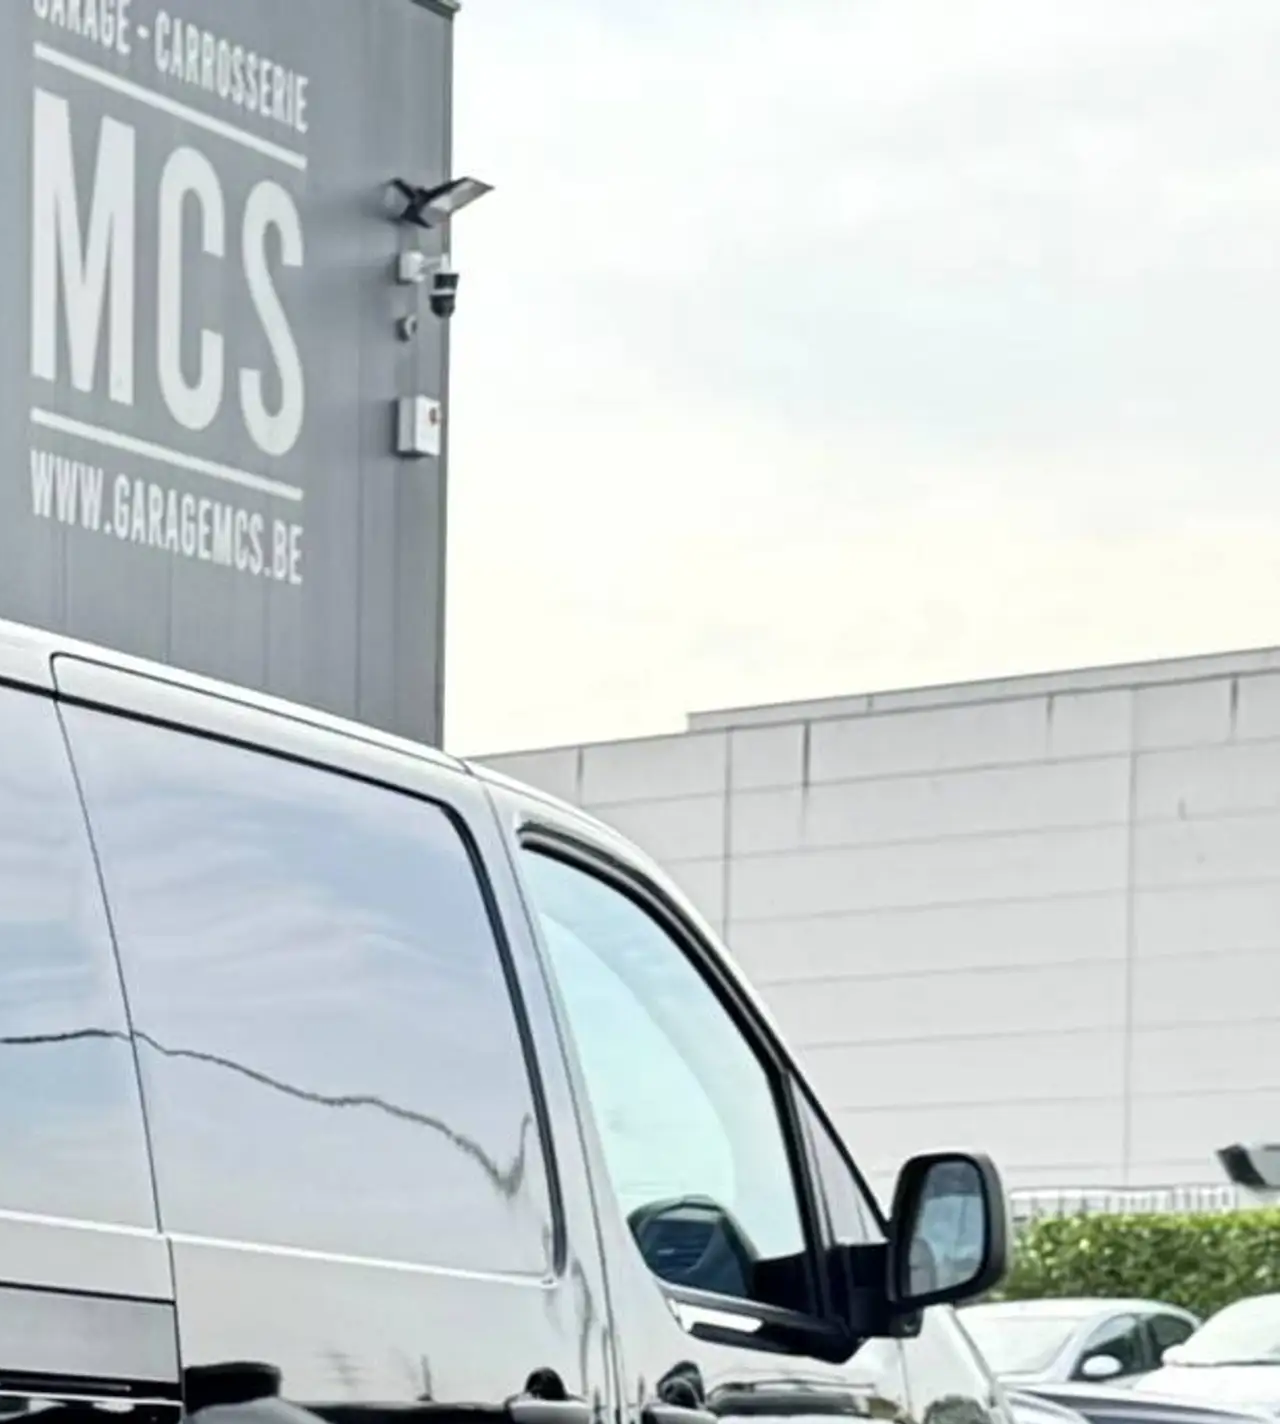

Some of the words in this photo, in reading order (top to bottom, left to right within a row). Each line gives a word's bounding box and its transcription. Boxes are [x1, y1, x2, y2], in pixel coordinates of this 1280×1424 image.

[33, 0, 131, 54] RAGE
[153, 9, 309, 133] CARROSSERIE
[32, 88, 304, 456] MCS
[31, 449, 303, 585] WWW.GARAGEMCS.BE
